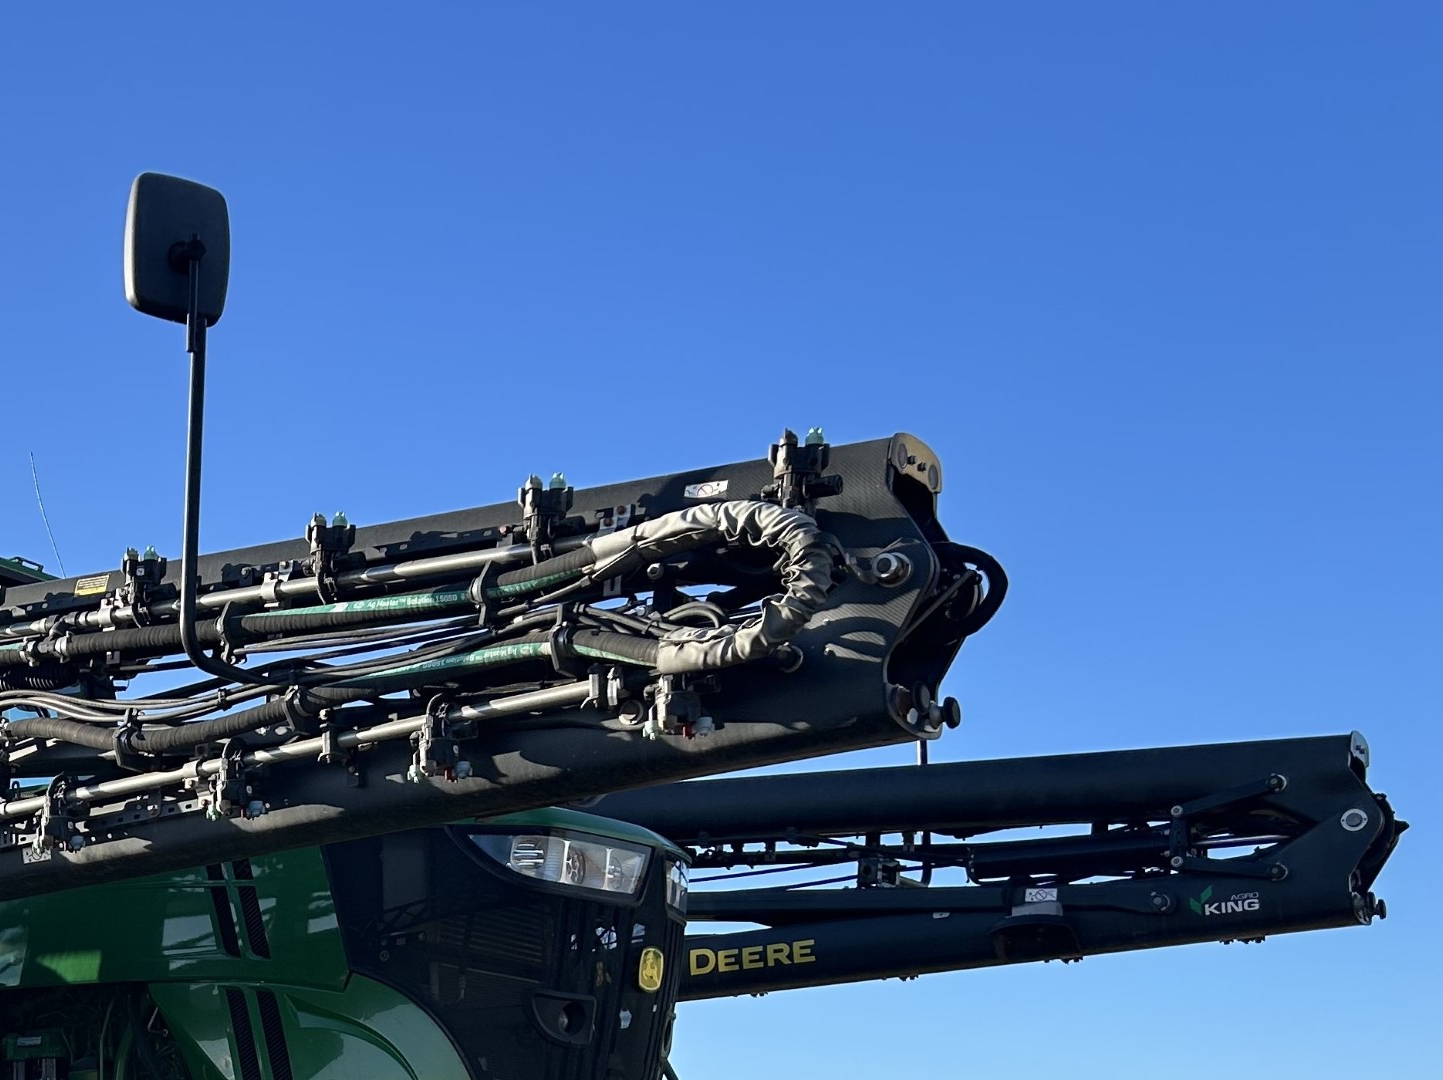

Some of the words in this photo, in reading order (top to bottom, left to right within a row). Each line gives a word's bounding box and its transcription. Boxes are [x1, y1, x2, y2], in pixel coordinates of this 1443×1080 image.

[1230, 891, 1259, 901] AGRO
[1204, 898, 1260, 916] KING
[689, 939, 816, 976] DEERE
